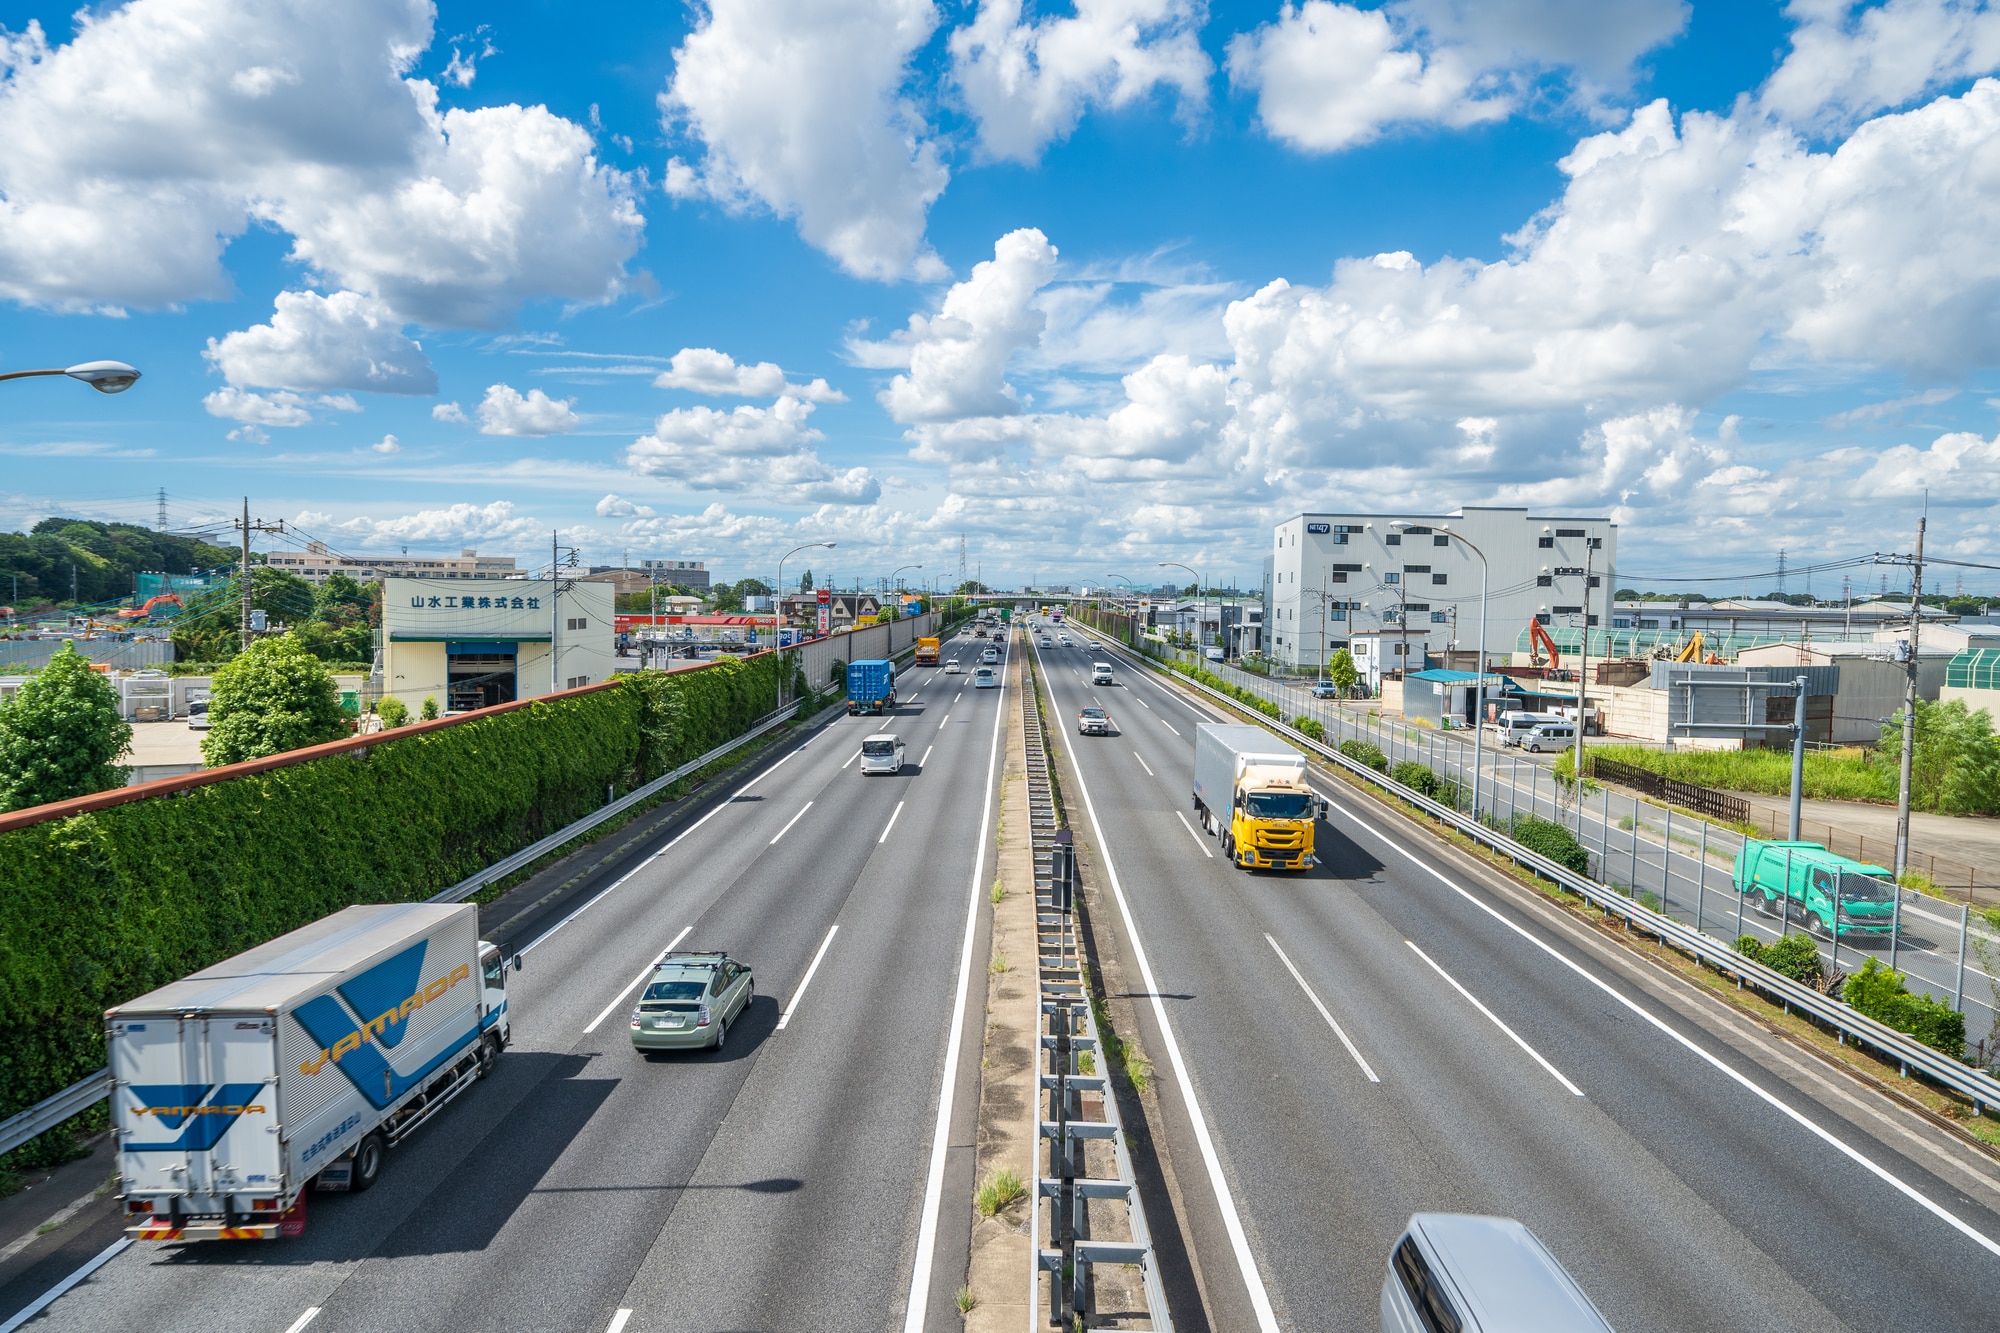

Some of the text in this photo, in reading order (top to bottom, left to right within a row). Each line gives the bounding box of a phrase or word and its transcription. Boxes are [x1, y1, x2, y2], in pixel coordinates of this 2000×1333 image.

[411, 595, 541, 610] 山水工業株式会社
[298, 963, 470, 1077] YAMADA
[129, 1104, 267, 1117] YAMADA
